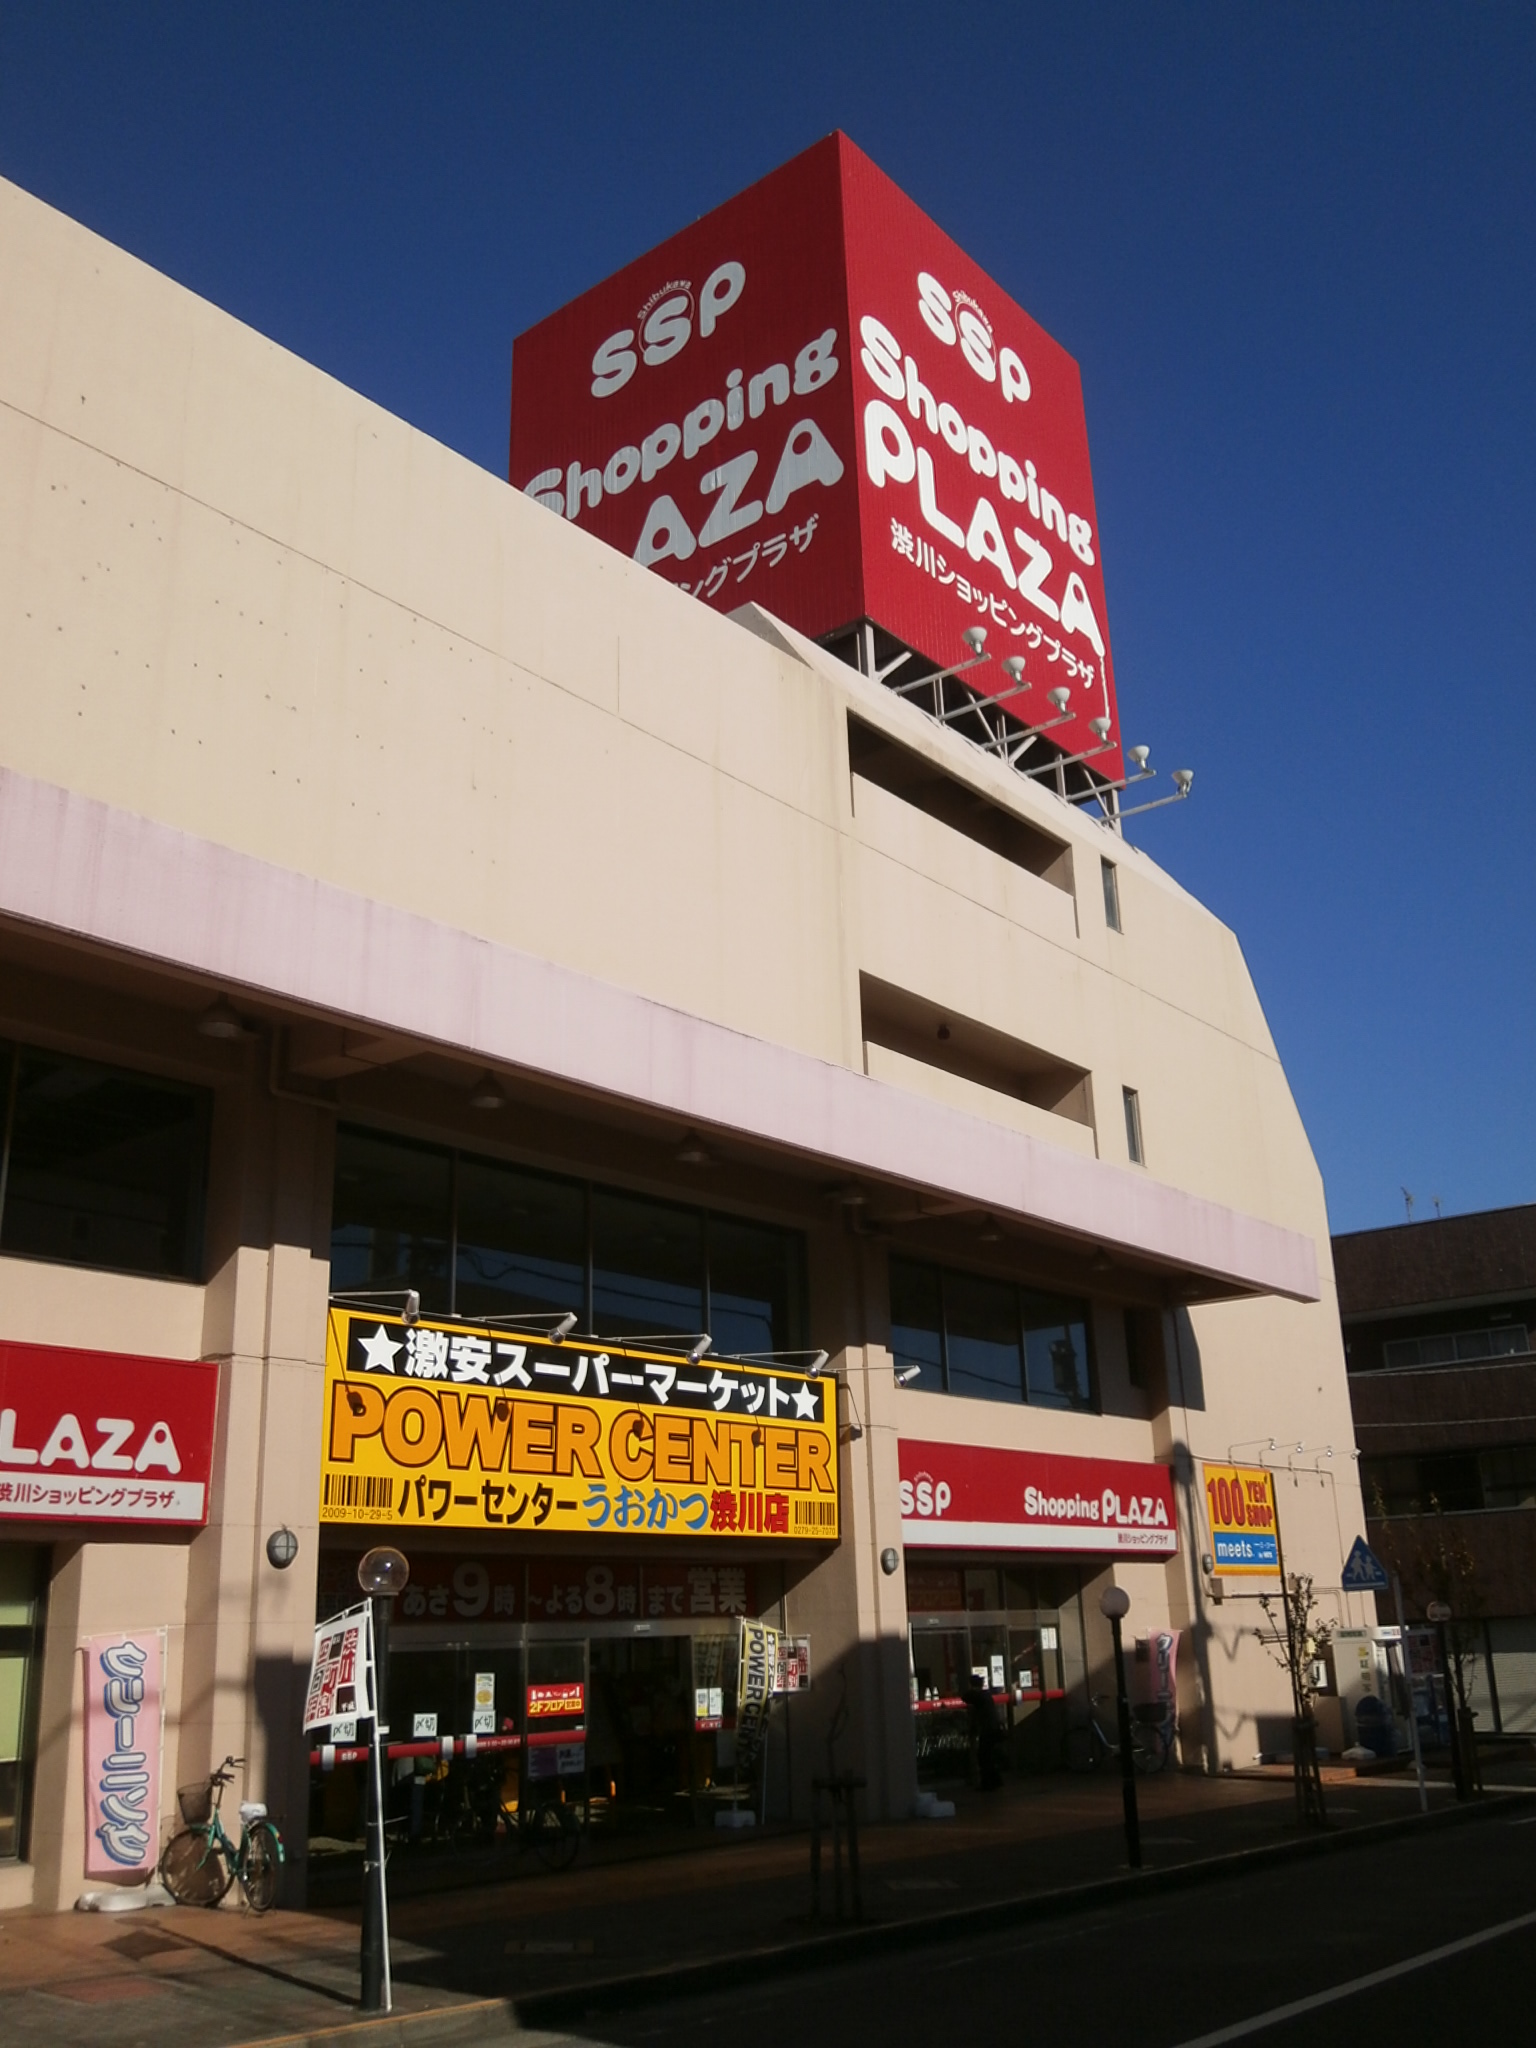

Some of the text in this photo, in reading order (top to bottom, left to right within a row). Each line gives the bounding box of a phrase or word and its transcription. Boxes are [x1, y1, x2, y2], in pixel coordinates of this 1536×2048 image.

[591, 261, 746, 398] SSP
[637, 279, 692, 320] Shibukawa
[917, 271, 1031, 403] SSP
[522, 328, 839, 520] Shopping
[860, 315, 1095, 566] Shopping
[633, 418, 844, 568] AZA
[864, 399, 1105, 658] PLAZA
[673, 513, 820, 599] ングプラザ
[890, 517, 1094, 689] 渋川ショッピングプラザ
[0, 1408, 182, 1475] LAZA
[328, 1379, 836, 1493] POWER CENTER
[900, 1480, 951, 1517] SSP
[1024, 1486, 1169, 1526] Shopping PLAZA
[1207, 1477, 1267, 1527] 100 YEN
[1246, 1504, 1273, 1528] SHOP
[746, 1628, 764, 1700] POWER
